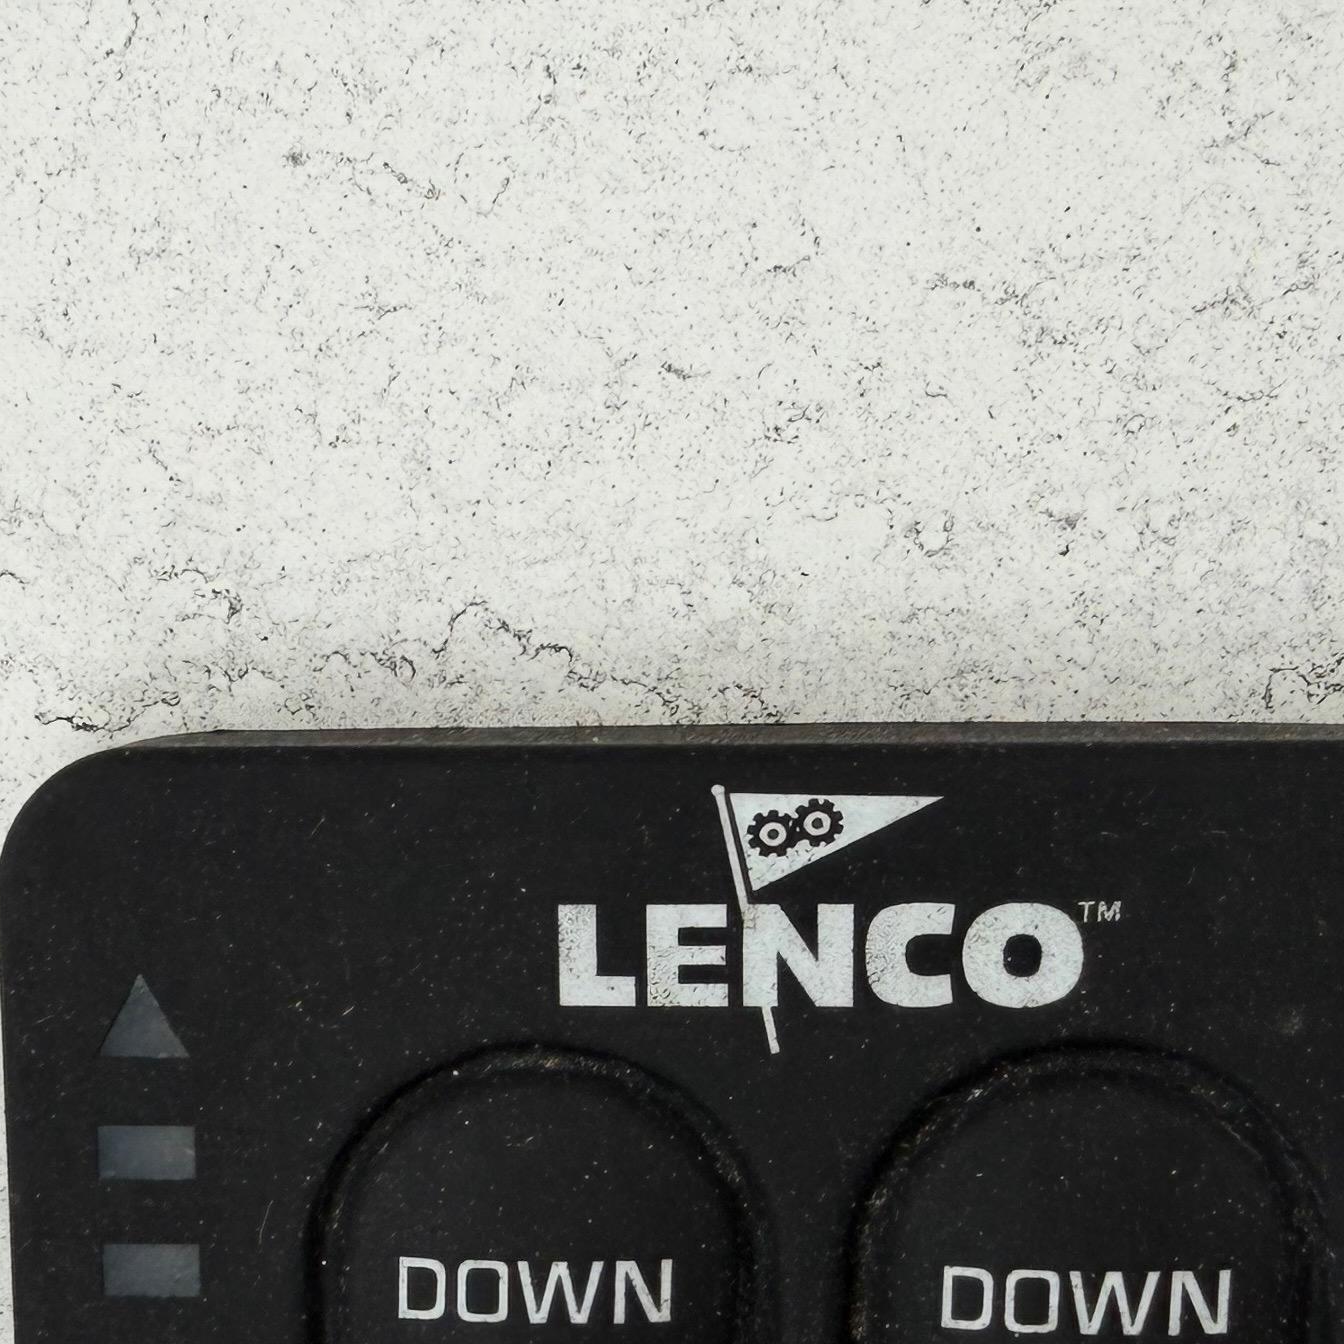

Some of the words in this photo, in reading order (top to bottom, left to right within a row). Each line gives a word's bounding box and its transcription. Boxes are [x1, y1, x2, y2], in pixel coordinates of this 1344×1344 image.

[557, 902, 1085, 1009] LENCO
[397, 1255, 673, 1325] DOWN
[940, 1265, 1232, 1337] DOWN
